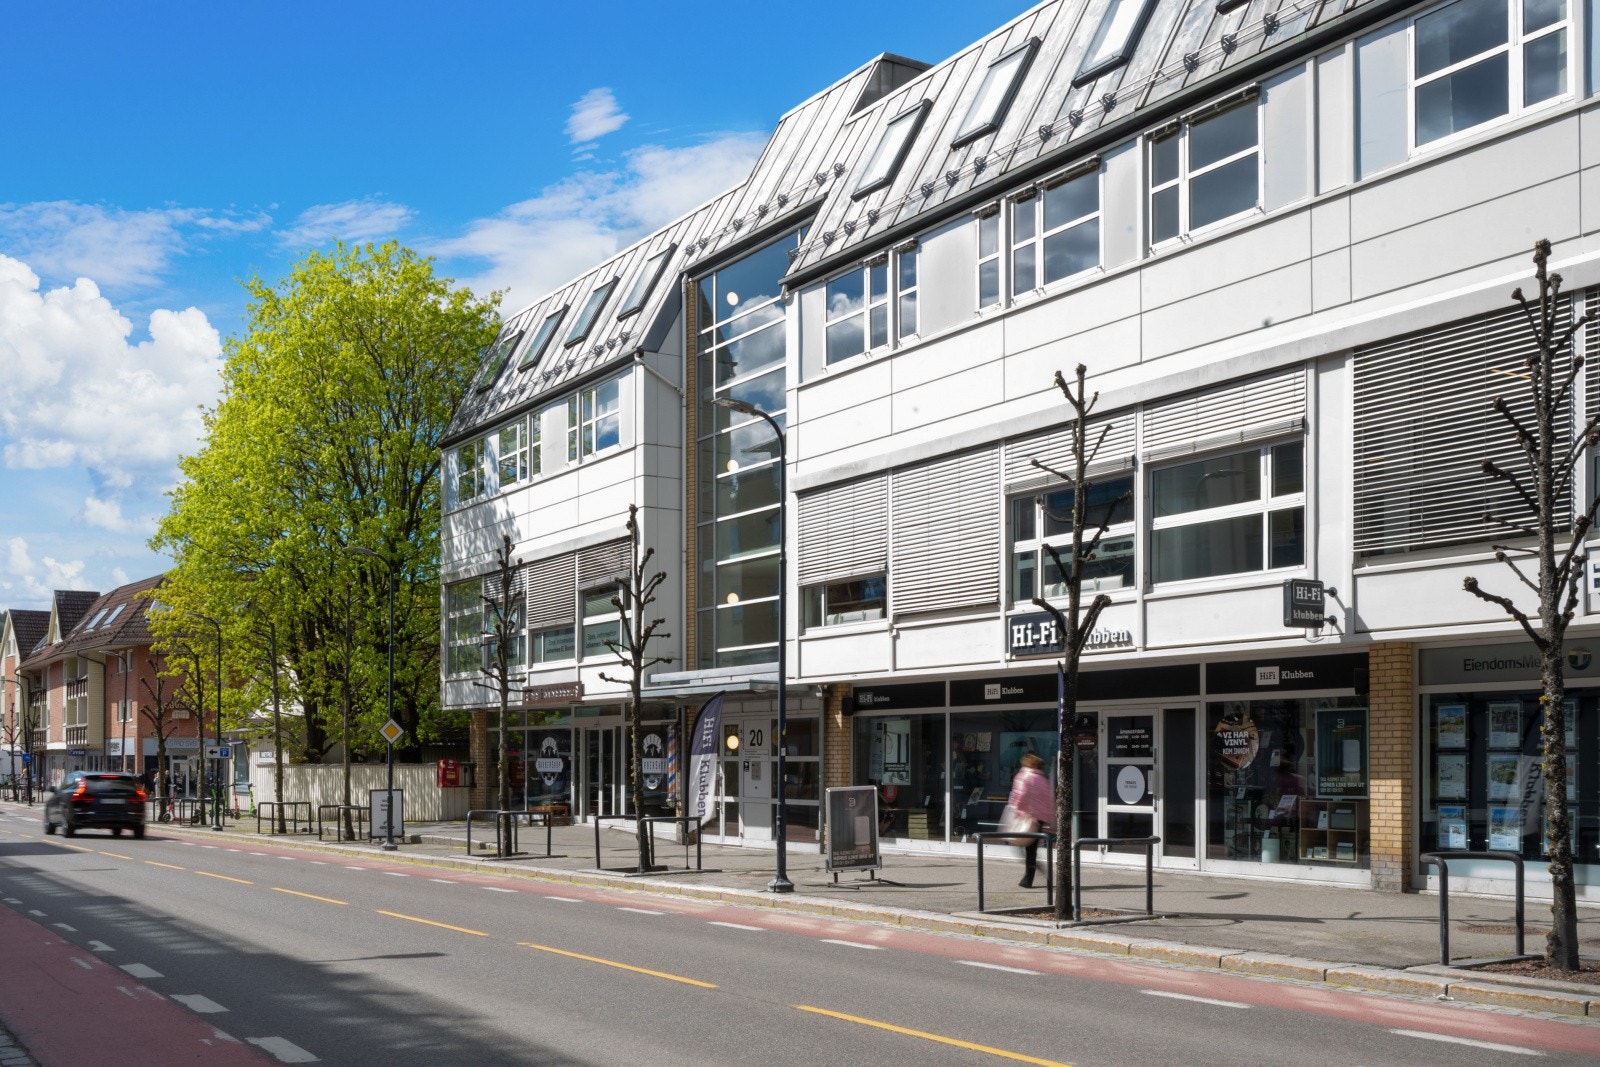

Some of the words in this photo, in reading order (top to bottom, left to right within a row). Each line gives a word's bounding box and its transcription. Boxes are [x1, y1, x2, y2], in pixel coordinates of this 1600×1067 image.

[1296, 586, 1321, 601] Hi-Fi
[1293, 609, 1324, 621] klubben
[1012, 619, 1058, 648] Hi-Fi
[1259, 671, 1276, 680] HiFi
[1281, 669, 1314, 680] Klubben
[1001, 687, 1024, 695] Klubben
[702, 716, 715, 747] HiFi
[749, 729, 763, 747] 20
[1222, 731, 1232, 739] VI
[1224, 738, 1248, 746] VINYL
[696, 758, 711, 817] Klubben
